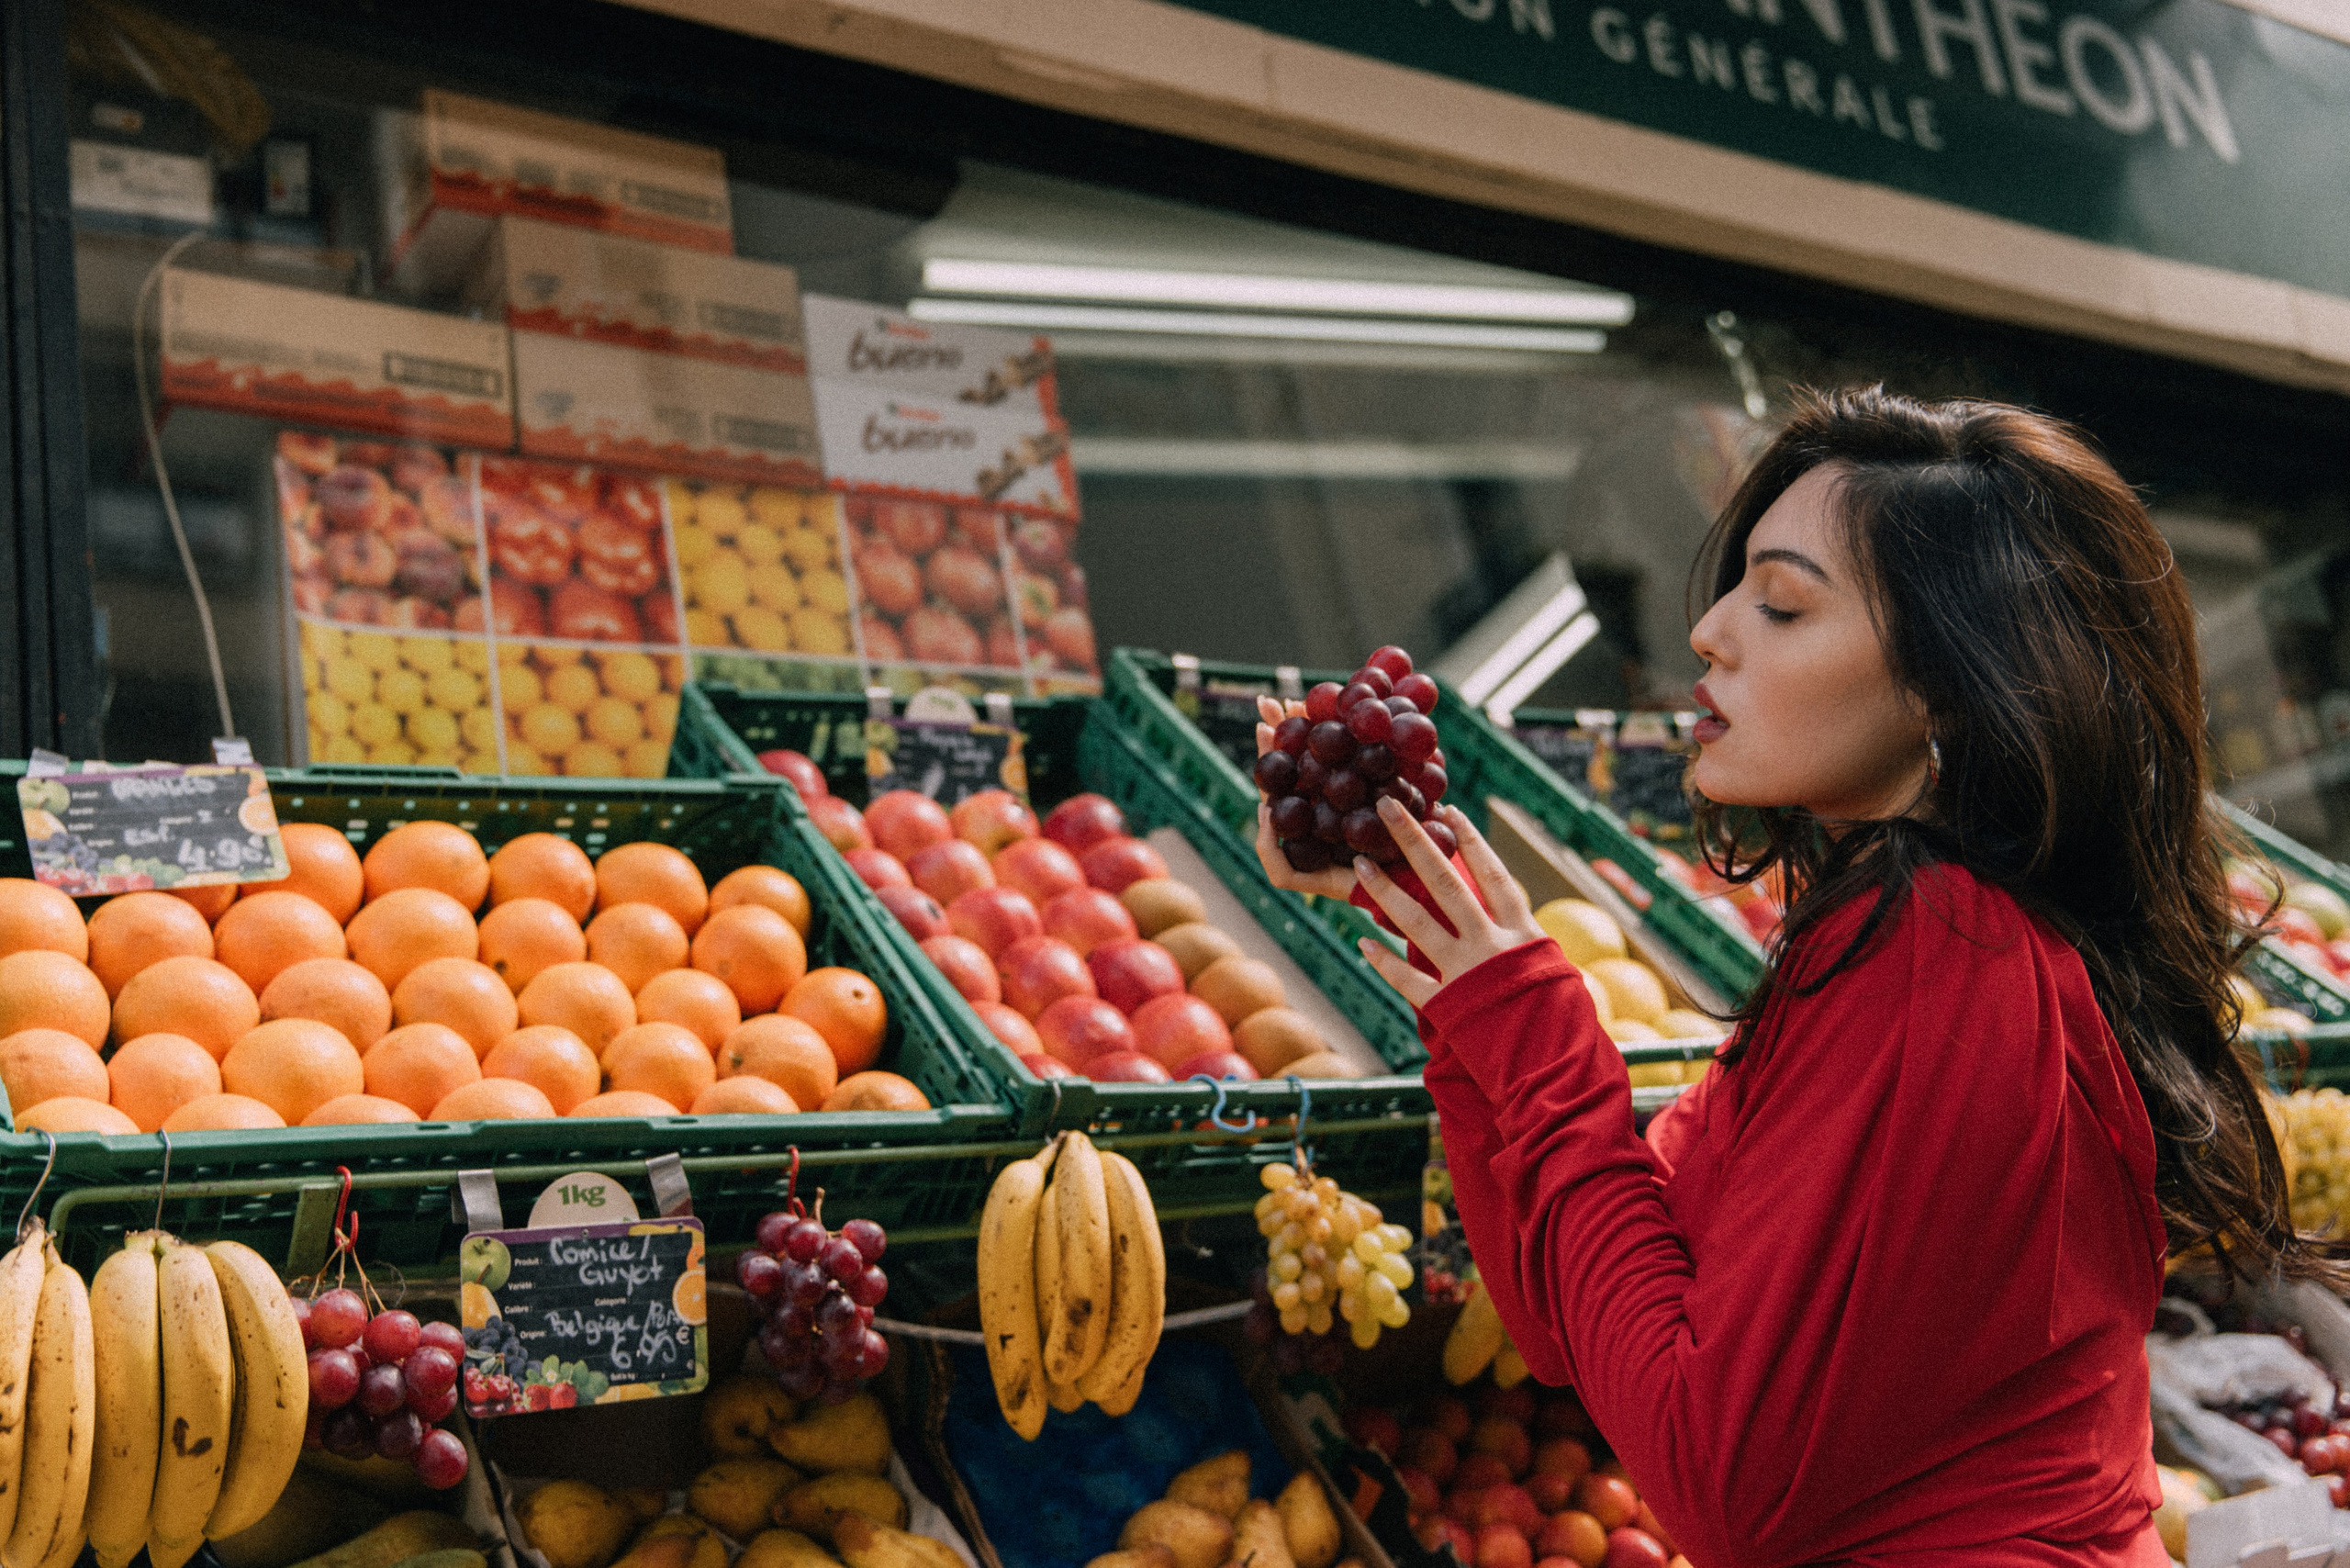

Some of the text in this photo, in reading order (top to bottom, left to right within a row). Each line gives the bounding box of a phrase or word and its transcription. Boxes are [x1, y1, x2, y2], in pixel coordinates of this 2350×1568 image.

[1590, 7, 1945, 151] GÉNÉRALE
[1728, 0, 2238, 163] HEON
[556, 1183, 607, 1208] 1kg
[579, 1254, 665, 1297] Guyot
[544, 1309, 641, 1347] Belgique
